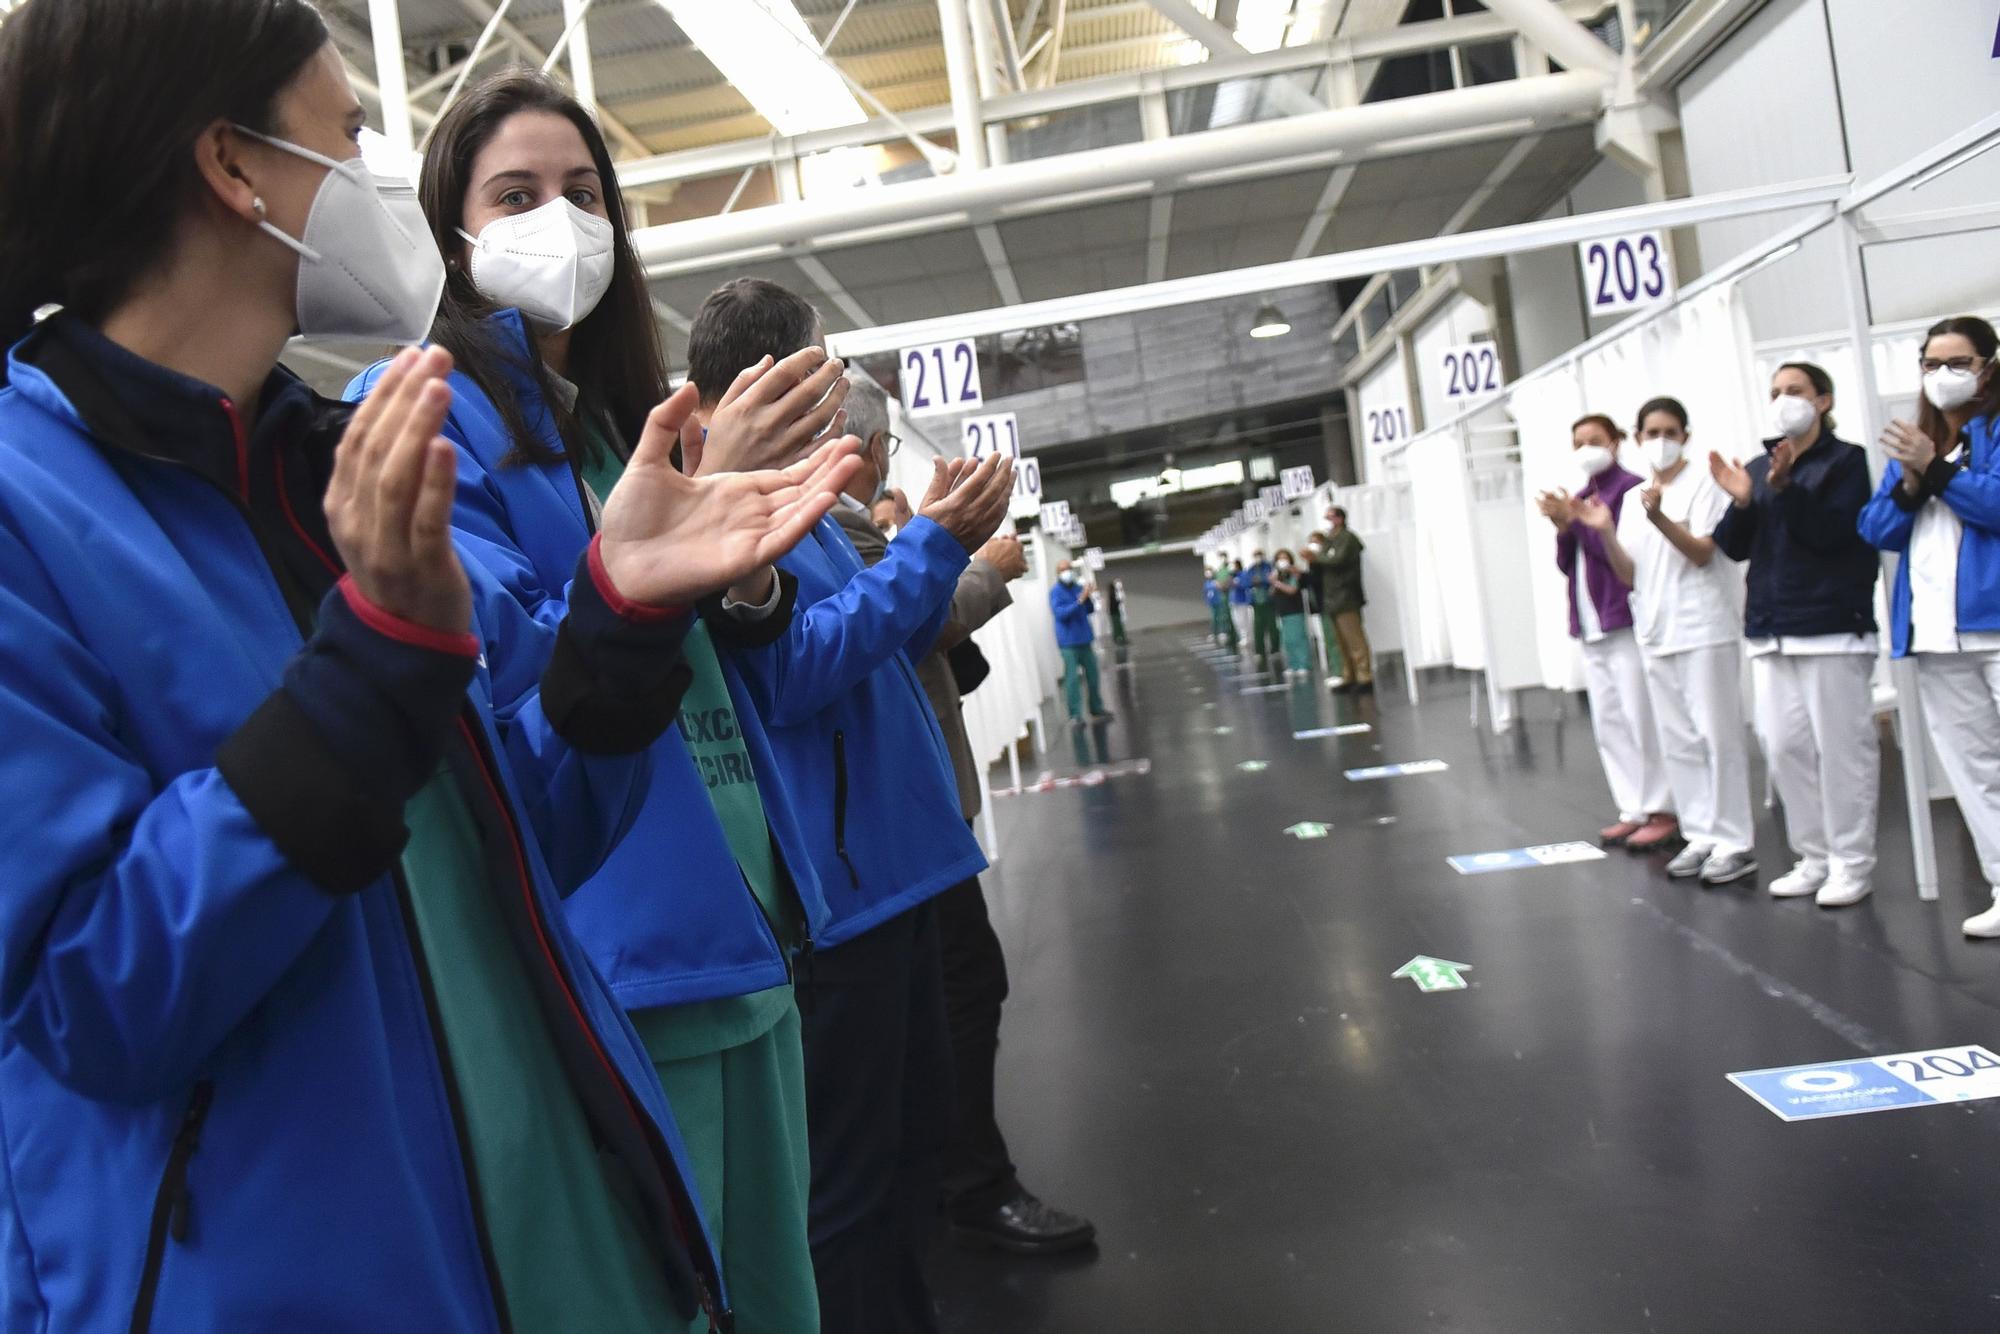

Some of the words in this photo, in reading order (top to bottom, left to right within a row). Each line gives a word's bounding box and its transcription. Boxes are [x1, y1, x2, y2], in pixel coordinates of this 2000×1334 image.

[1588, 235, 1663, 305] 203
[907, 341, 978, 409] 212
[1443, 349, 1497, 395] 202
[967, 420, 1017, 463] 211
[1368, 405, 1408, 443] 201
[1013, 463, 1039, 496] 10
[1886, 1050, 2000, 1082] 204
